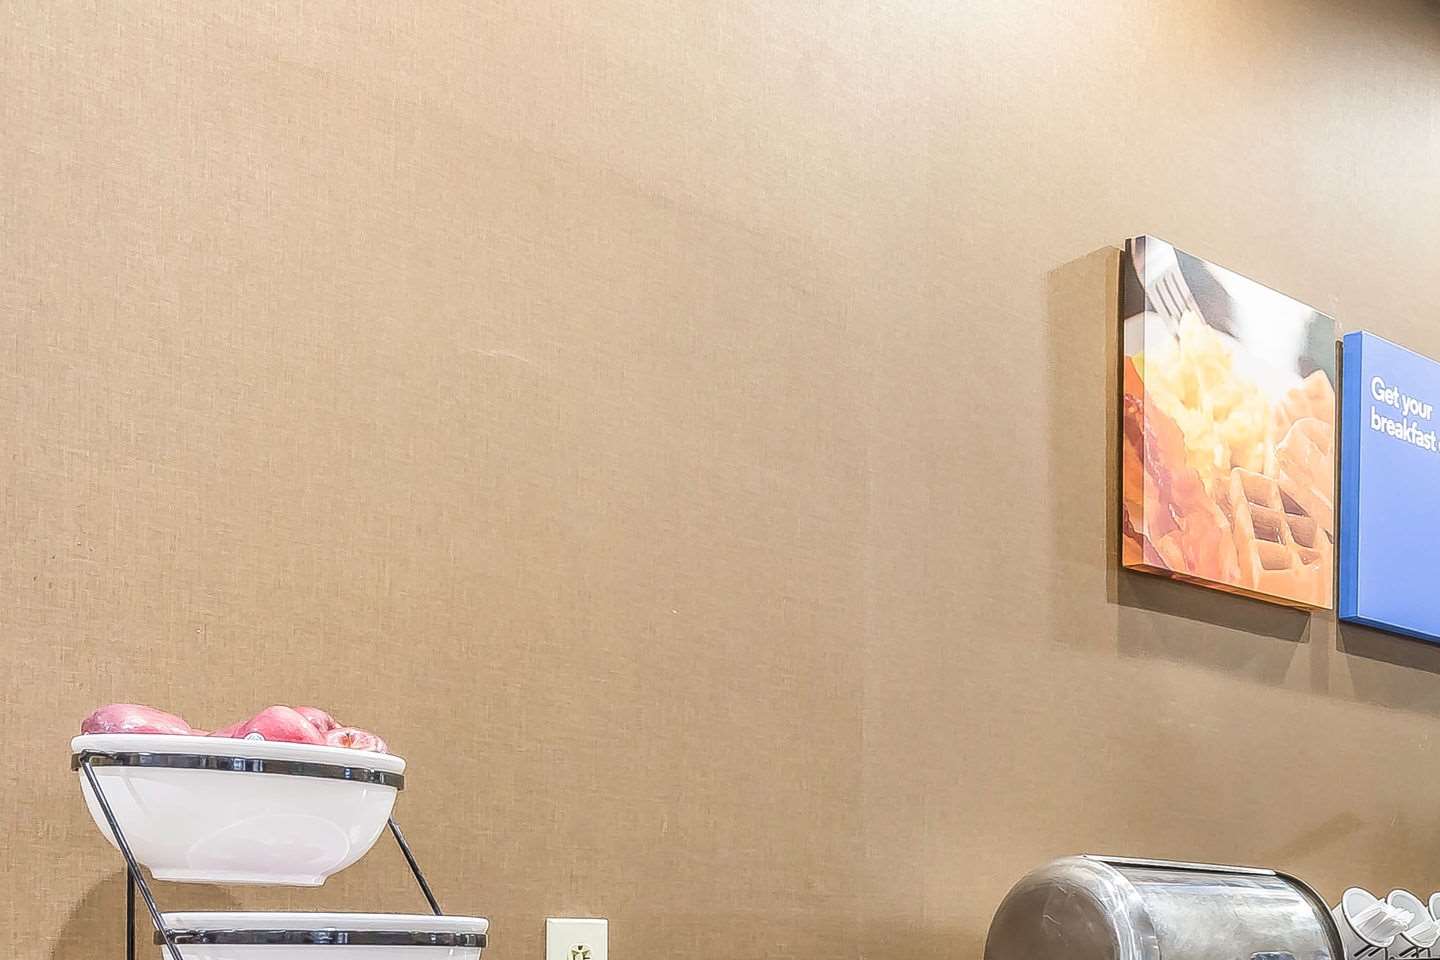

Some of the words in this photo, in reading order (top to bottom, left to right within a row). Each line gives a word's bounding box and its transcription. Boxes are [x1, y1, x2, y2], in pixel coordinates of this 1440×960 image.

[1371, 376, 1400, 408] Get
[1400, 392, 1433, 420] your
[1370, 406, 1437, 452] breakfast
